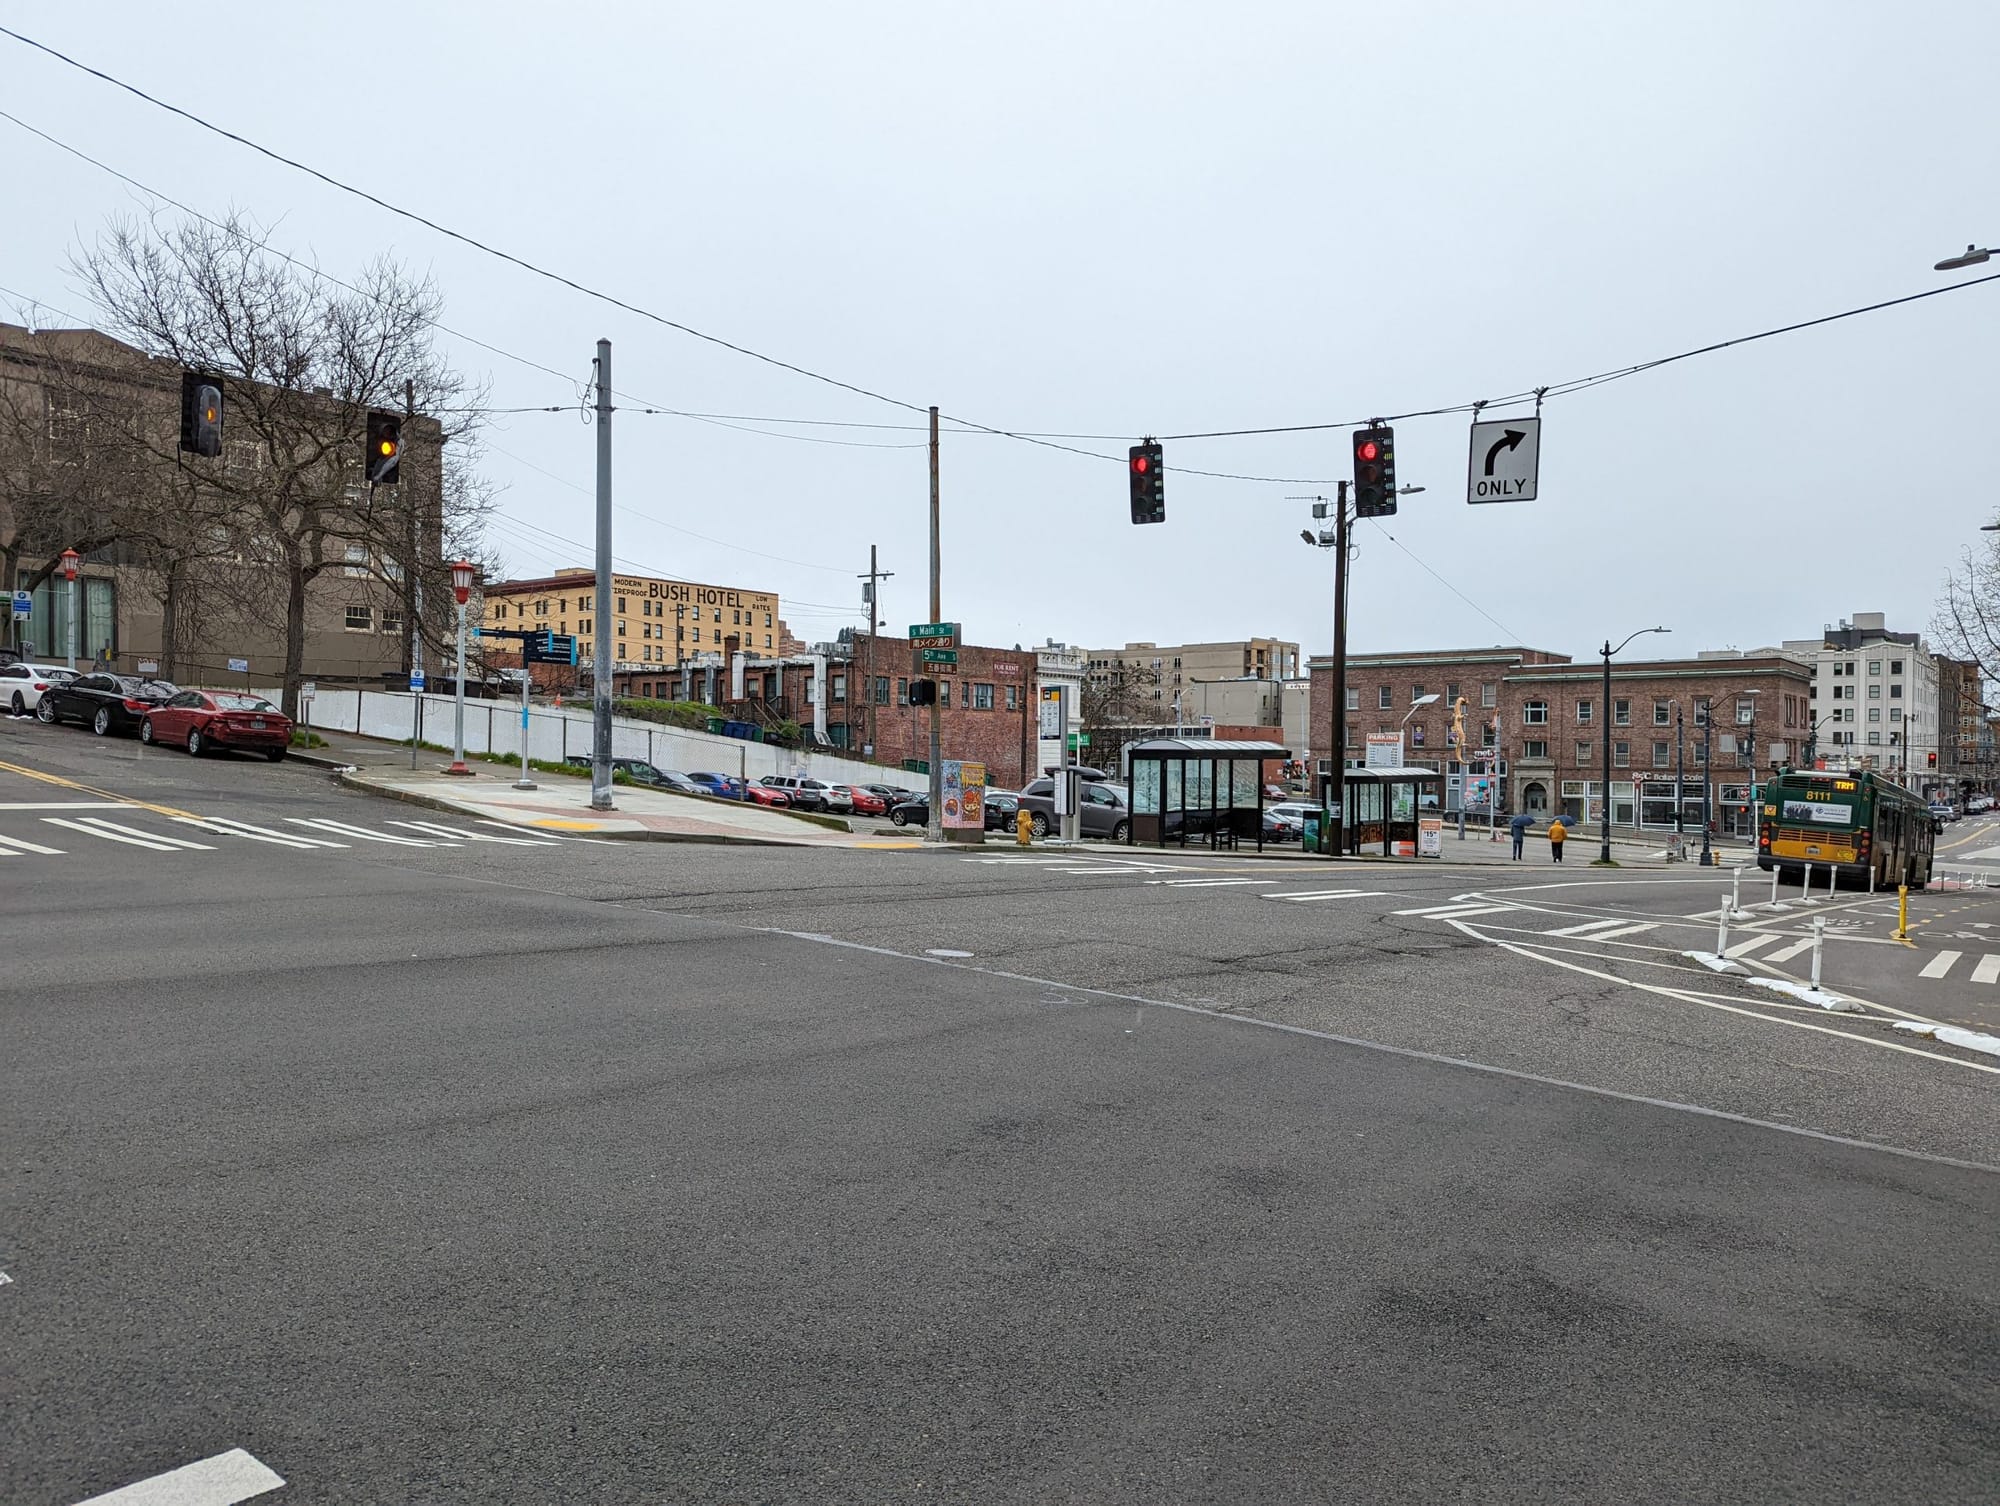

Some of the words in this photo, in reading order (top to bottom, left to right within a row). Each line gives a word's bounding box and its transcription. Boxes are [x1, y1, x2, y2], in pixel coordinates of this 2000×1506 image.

[1477, 479, 1526, 496] ONLY
[614, 578, 642, 587] MODERN
[649, 582, 690, 602] BUSH
[696, 588, 744, 609] HOTEL
[752, 603, 770, 611] RATES
[919, 625, 935, 636] Main
[993, 663, 1004, 671] FOR
[1005, 664, 1019, 672] RENT
[1368, 734, 1399, 742] PARKING
[1835, 781, 1855, 791] TRM
[1806, 790, 1831, 801] 8111
